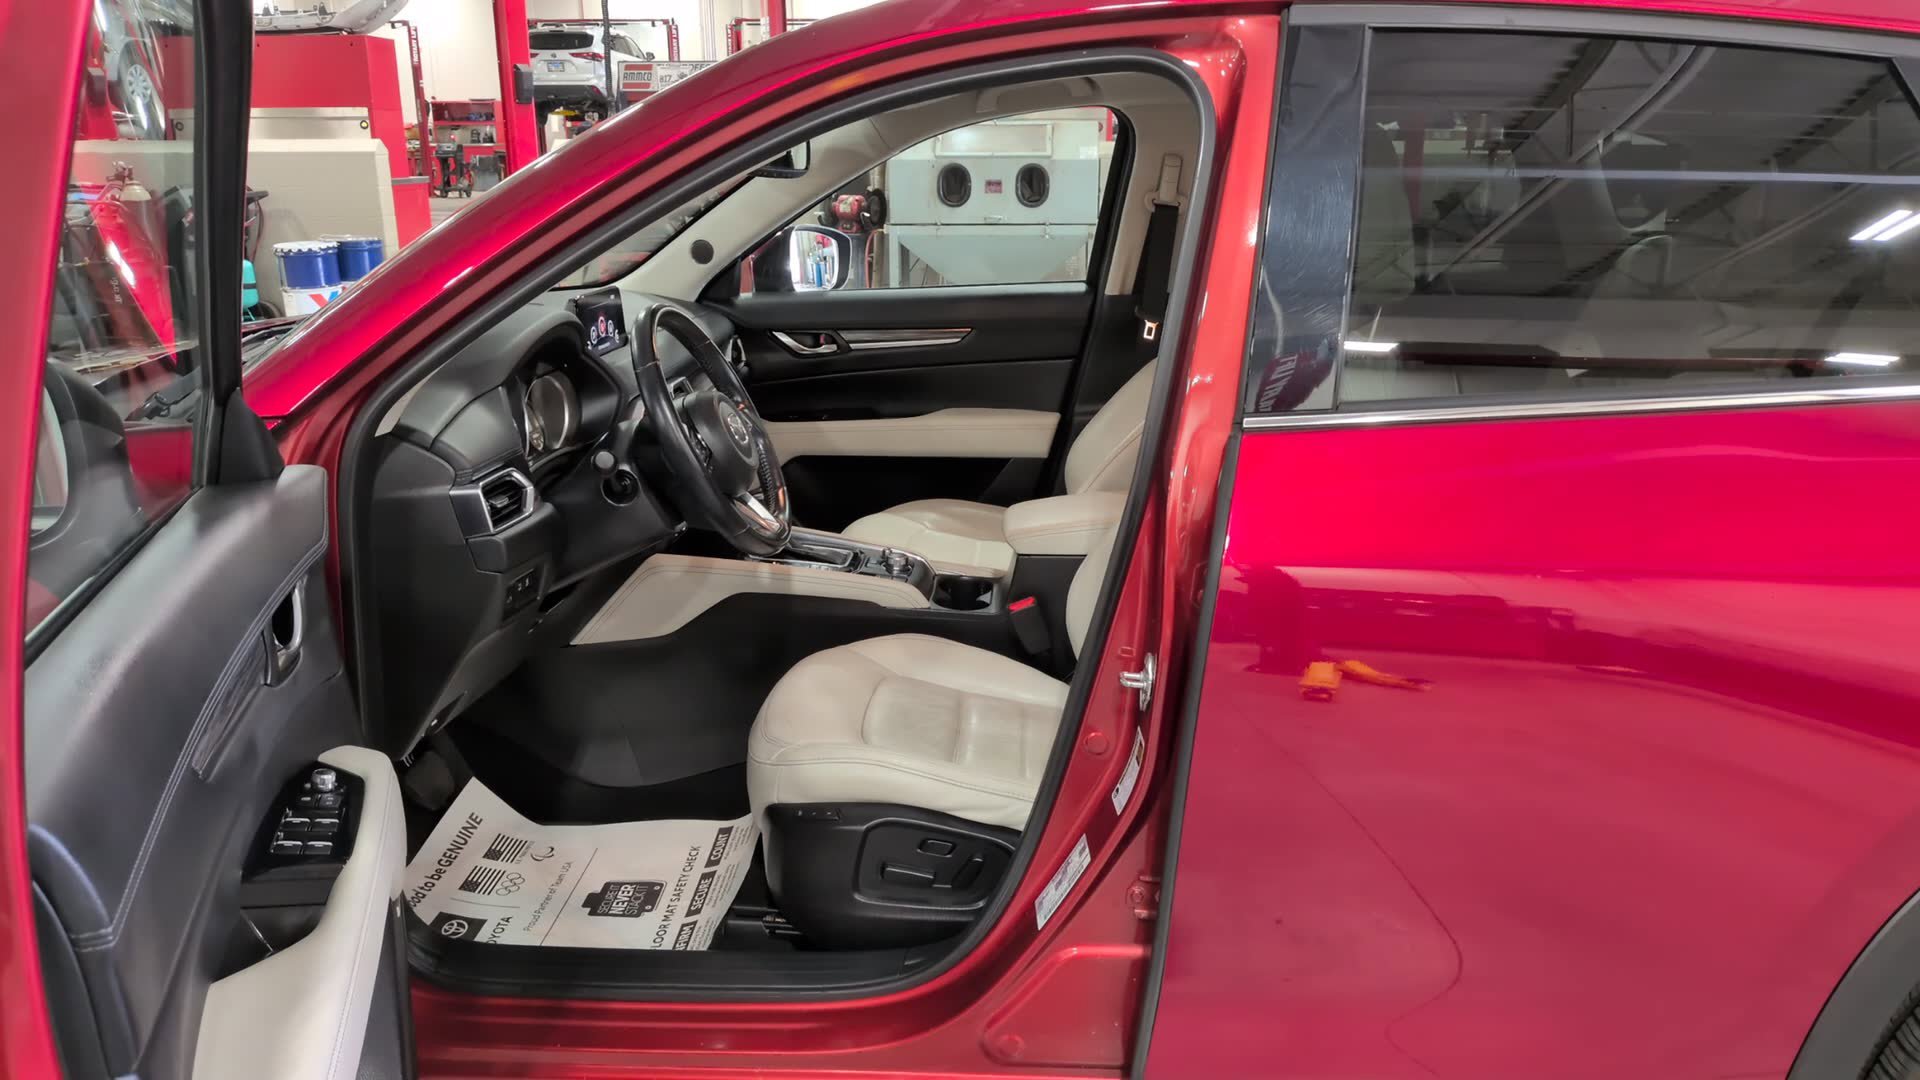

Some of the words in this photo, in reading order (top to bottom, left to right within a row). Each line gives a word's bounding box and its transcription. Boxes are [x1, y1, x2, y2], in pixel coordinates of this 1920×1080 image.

[623, 71, 652, 81] AMMCO
[438, 812, 484, 868] GENUINE
[711, 834, 729, 861] COUNT
[417, 881, 436, 892] to
[424, 867, 447, 881] be
[523, 913, 541, 932] Proud
[534, 893, 553, 915] Partner
[551, 873, 566, 887] Team
[560, 861, 573, 873] USA
[597, 890, 618, 914] SECURE
[608, 884, 637, 915] NEVER
[625, 891, 647, 915] STACK
[651, 923, 671, 949] LOOR
[662, 904, 678, 922] MAT
[670, 873, 690, 902] SAFETY
[683, 845, 701, 873] CHECK
[691, 877, 712, 911] SECURE
